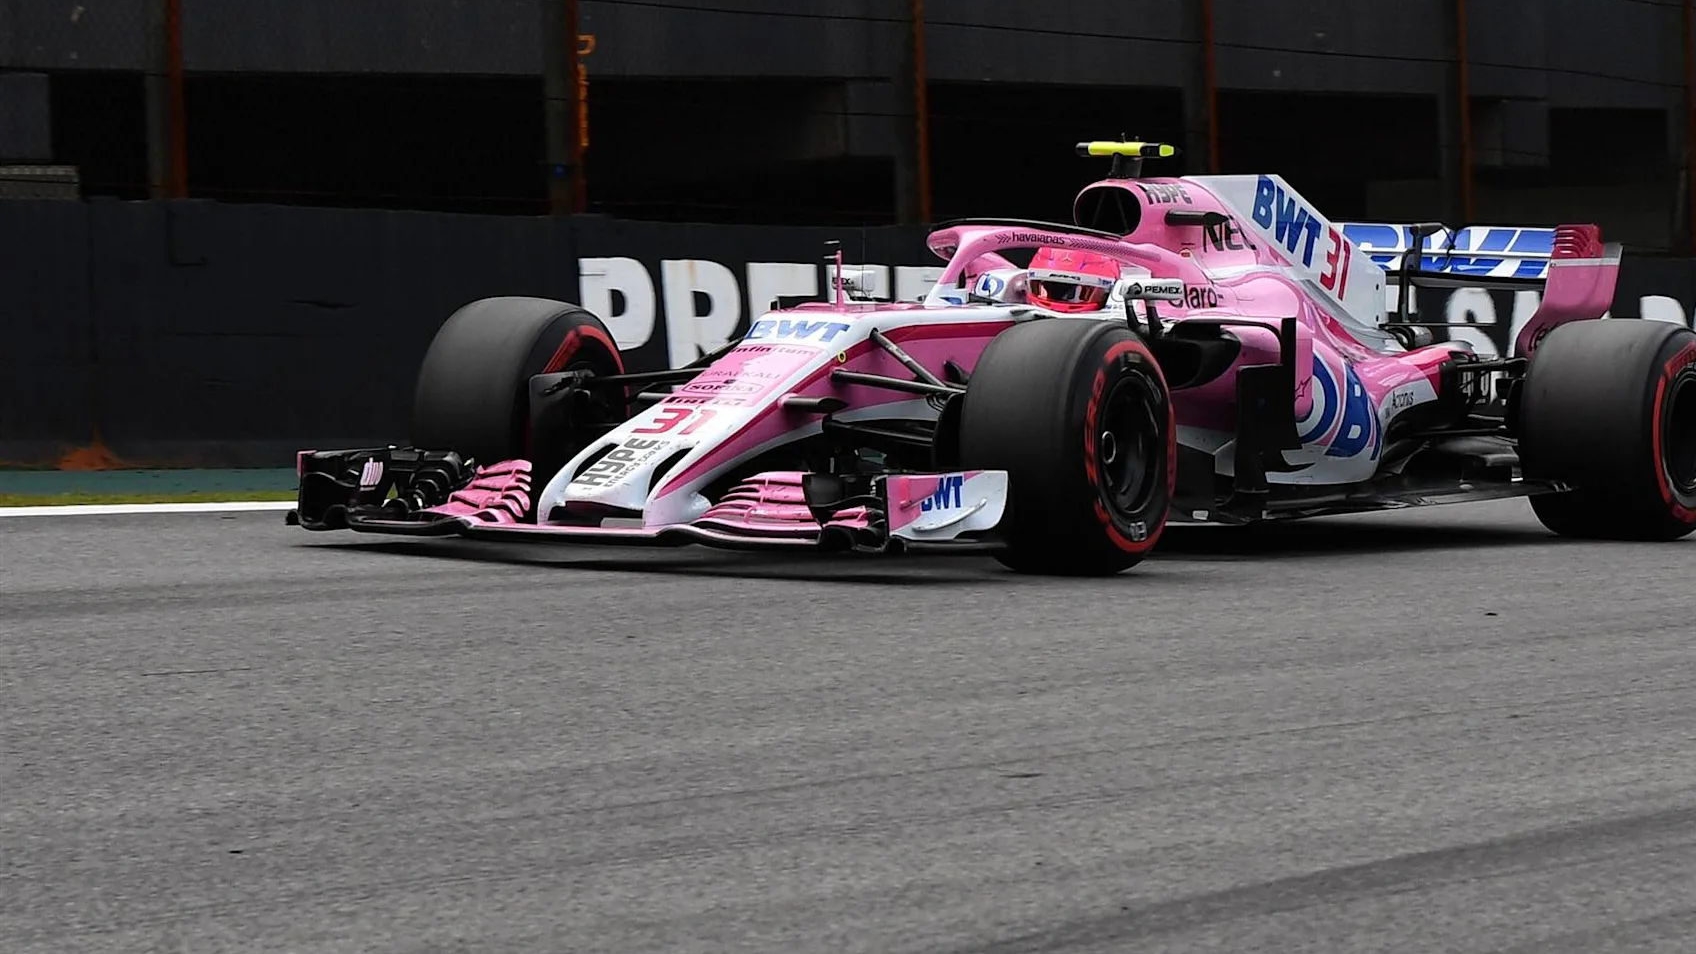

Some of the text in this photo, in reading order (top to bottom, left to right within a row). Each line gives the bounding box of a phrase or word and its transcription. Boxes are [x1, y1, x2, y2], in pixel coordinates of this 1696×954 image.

[1252, 175, 1351, 301] BWT 31
[1145, 285, 1181, 295] PEMEX
[744, 320, 851, 343] BWT
[632, 408, 717, 435] 31
[570, 437, 660, 487] HYPE
